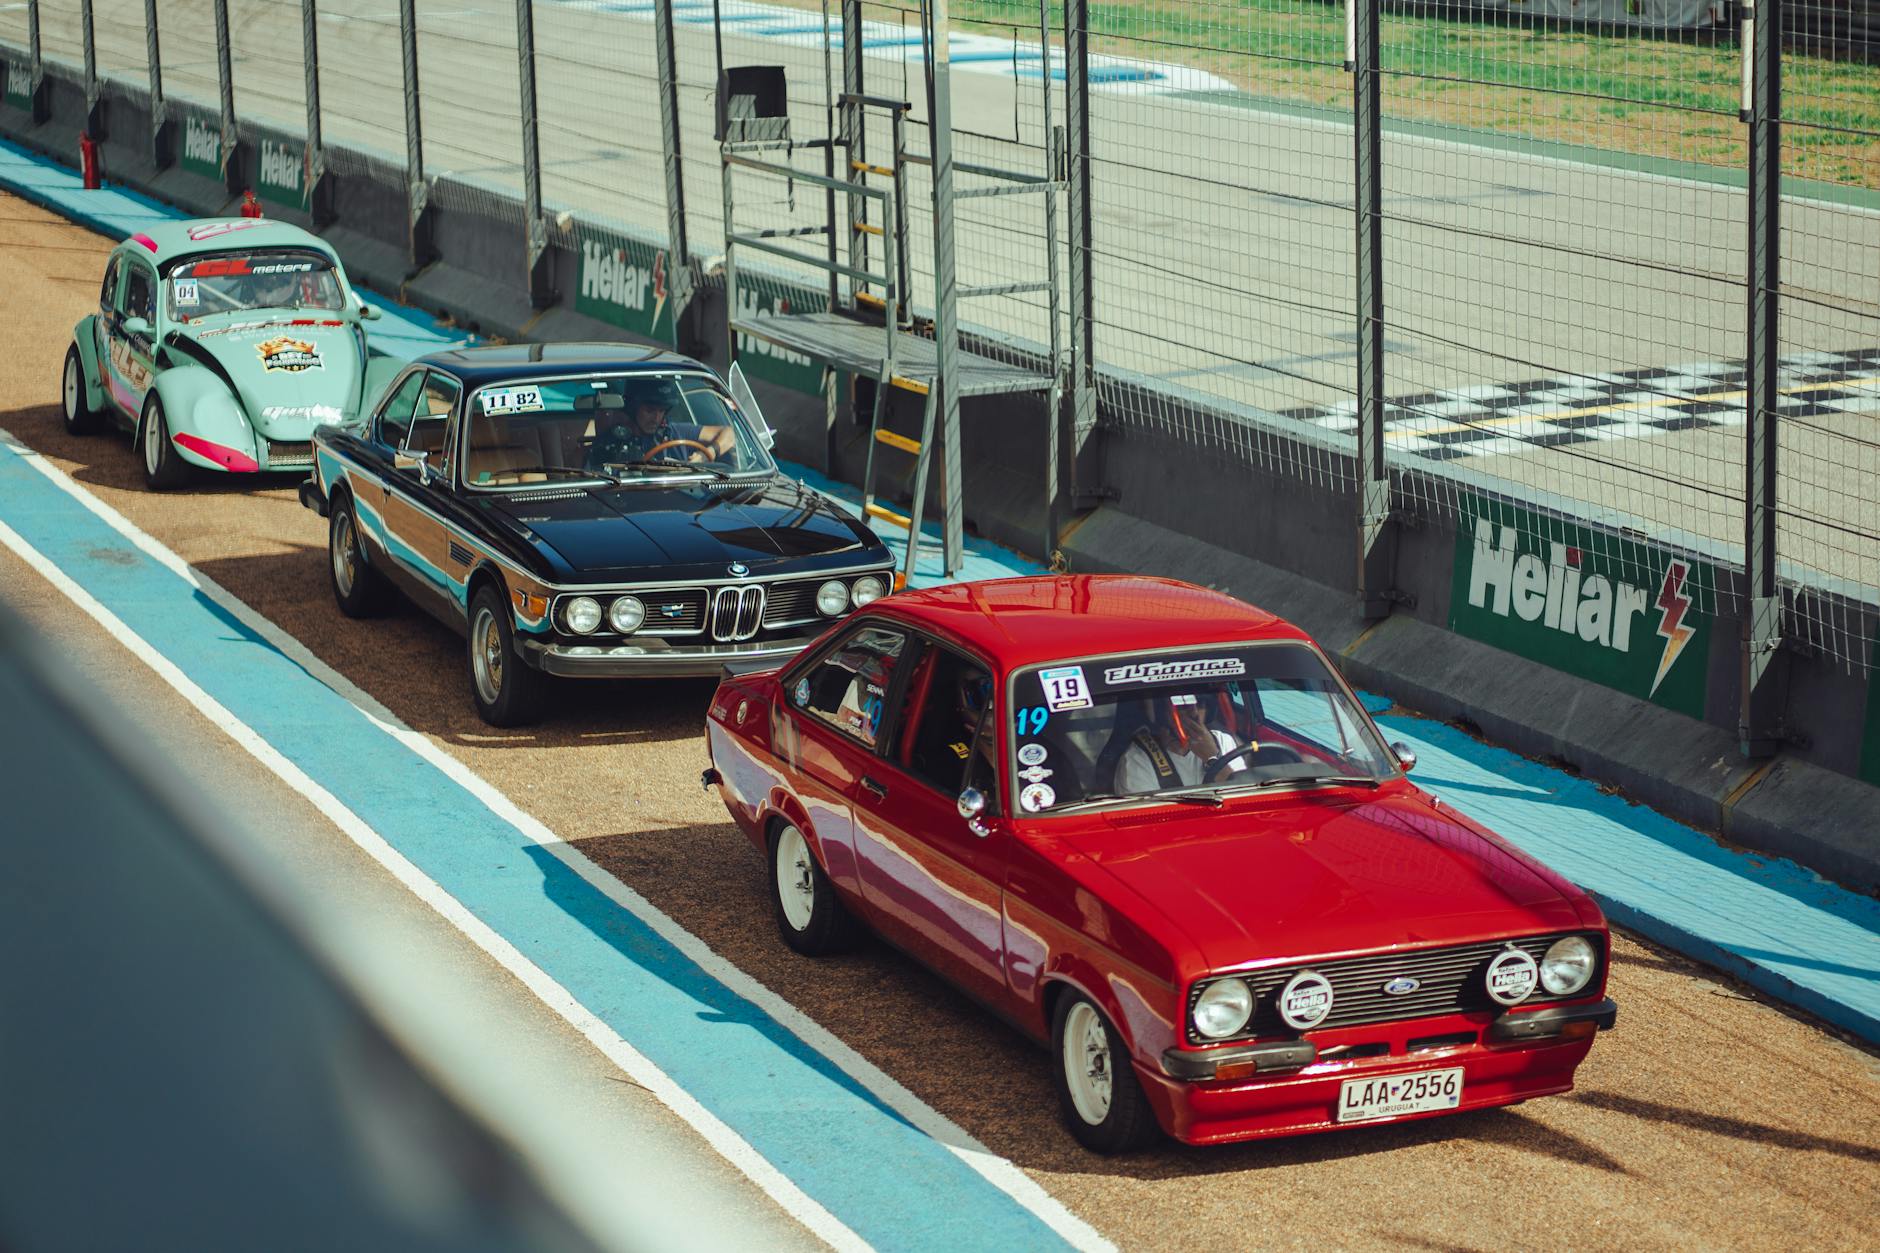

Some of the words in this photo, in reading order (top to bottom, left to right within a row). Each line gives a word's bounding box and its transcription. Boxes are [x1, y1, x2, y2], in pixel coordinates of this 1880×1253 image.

[184, 116, 220, 165] Heliar
[260, 140, 303, 190] Heliar
[582, 239, 650, 312] Heliar
[178, 286, 194, 299] 04
[489, 395, 506, 408] 11
[516, 392, 537, 405] 82
[1468, 516, 1648, 653] Heliar
[1051, 678, 1080, 699] 19
[1017, 706, 1048, 735] 19
[1494, 971, 1530, 987] Hella
[1289, 994, 1326, 1010] Hella
[1378, 1102, 1420, 1114] URUGUAY
